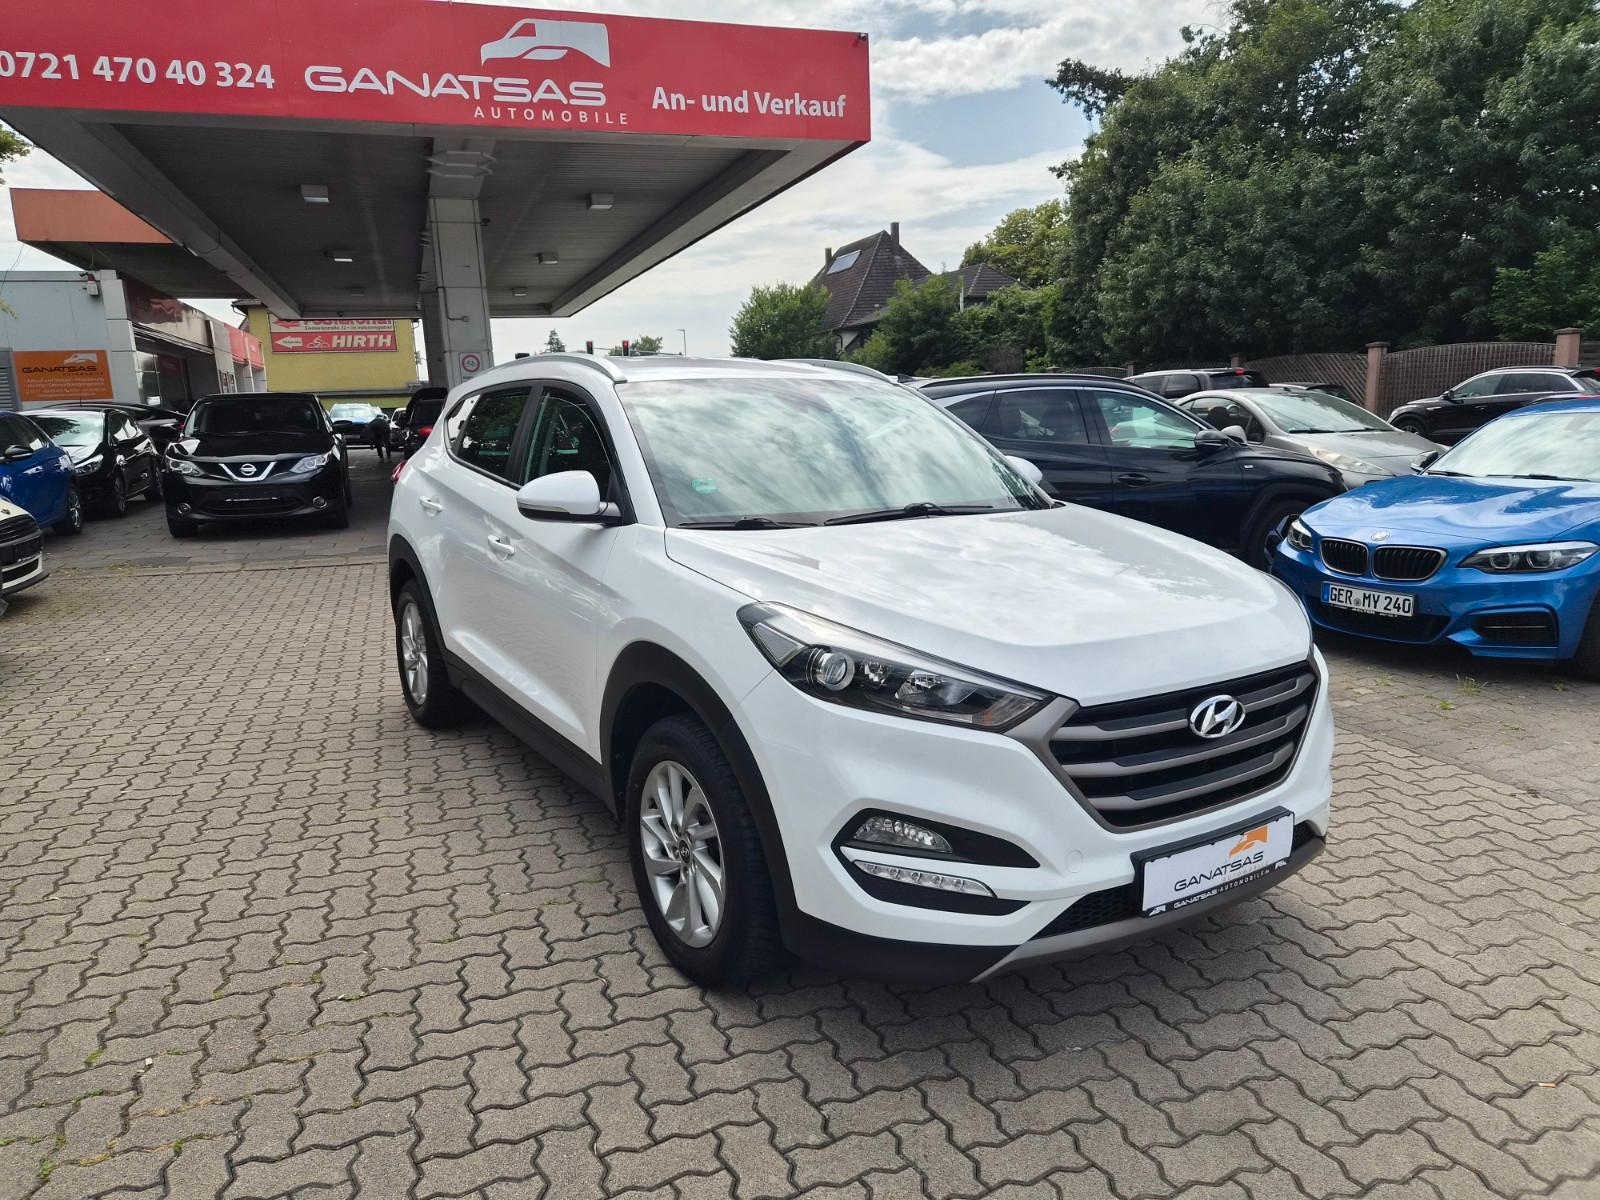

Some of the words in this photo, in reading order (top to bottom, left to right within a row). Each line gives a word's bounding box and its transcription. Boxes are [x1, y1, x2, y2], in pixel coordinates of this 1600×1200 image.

[0, 50, 79, 80] 0721
[92, 56, 156, 84] 470
[165, 60, 206, 86] 40
[214, 62, 275, 89] 324
[305, 65, 607, 106] GANATSAS
[474, 106, 628, 125] AUTOMOBILE
[652, 86, 695, 110] An-
[702, 90, 749, 113] und
[754, 92, 847, 117] Verkauf
[331, 335, 392, 348] HIRTH
[22, 365, 97, 374] GANATSAS
[1330, 587, 1353, 604] GER
[1362, 592, 1380, 609] MY
[1383, 596, 1412, 614] 240
[1174, 851, 1264, 892] GANATSAS
